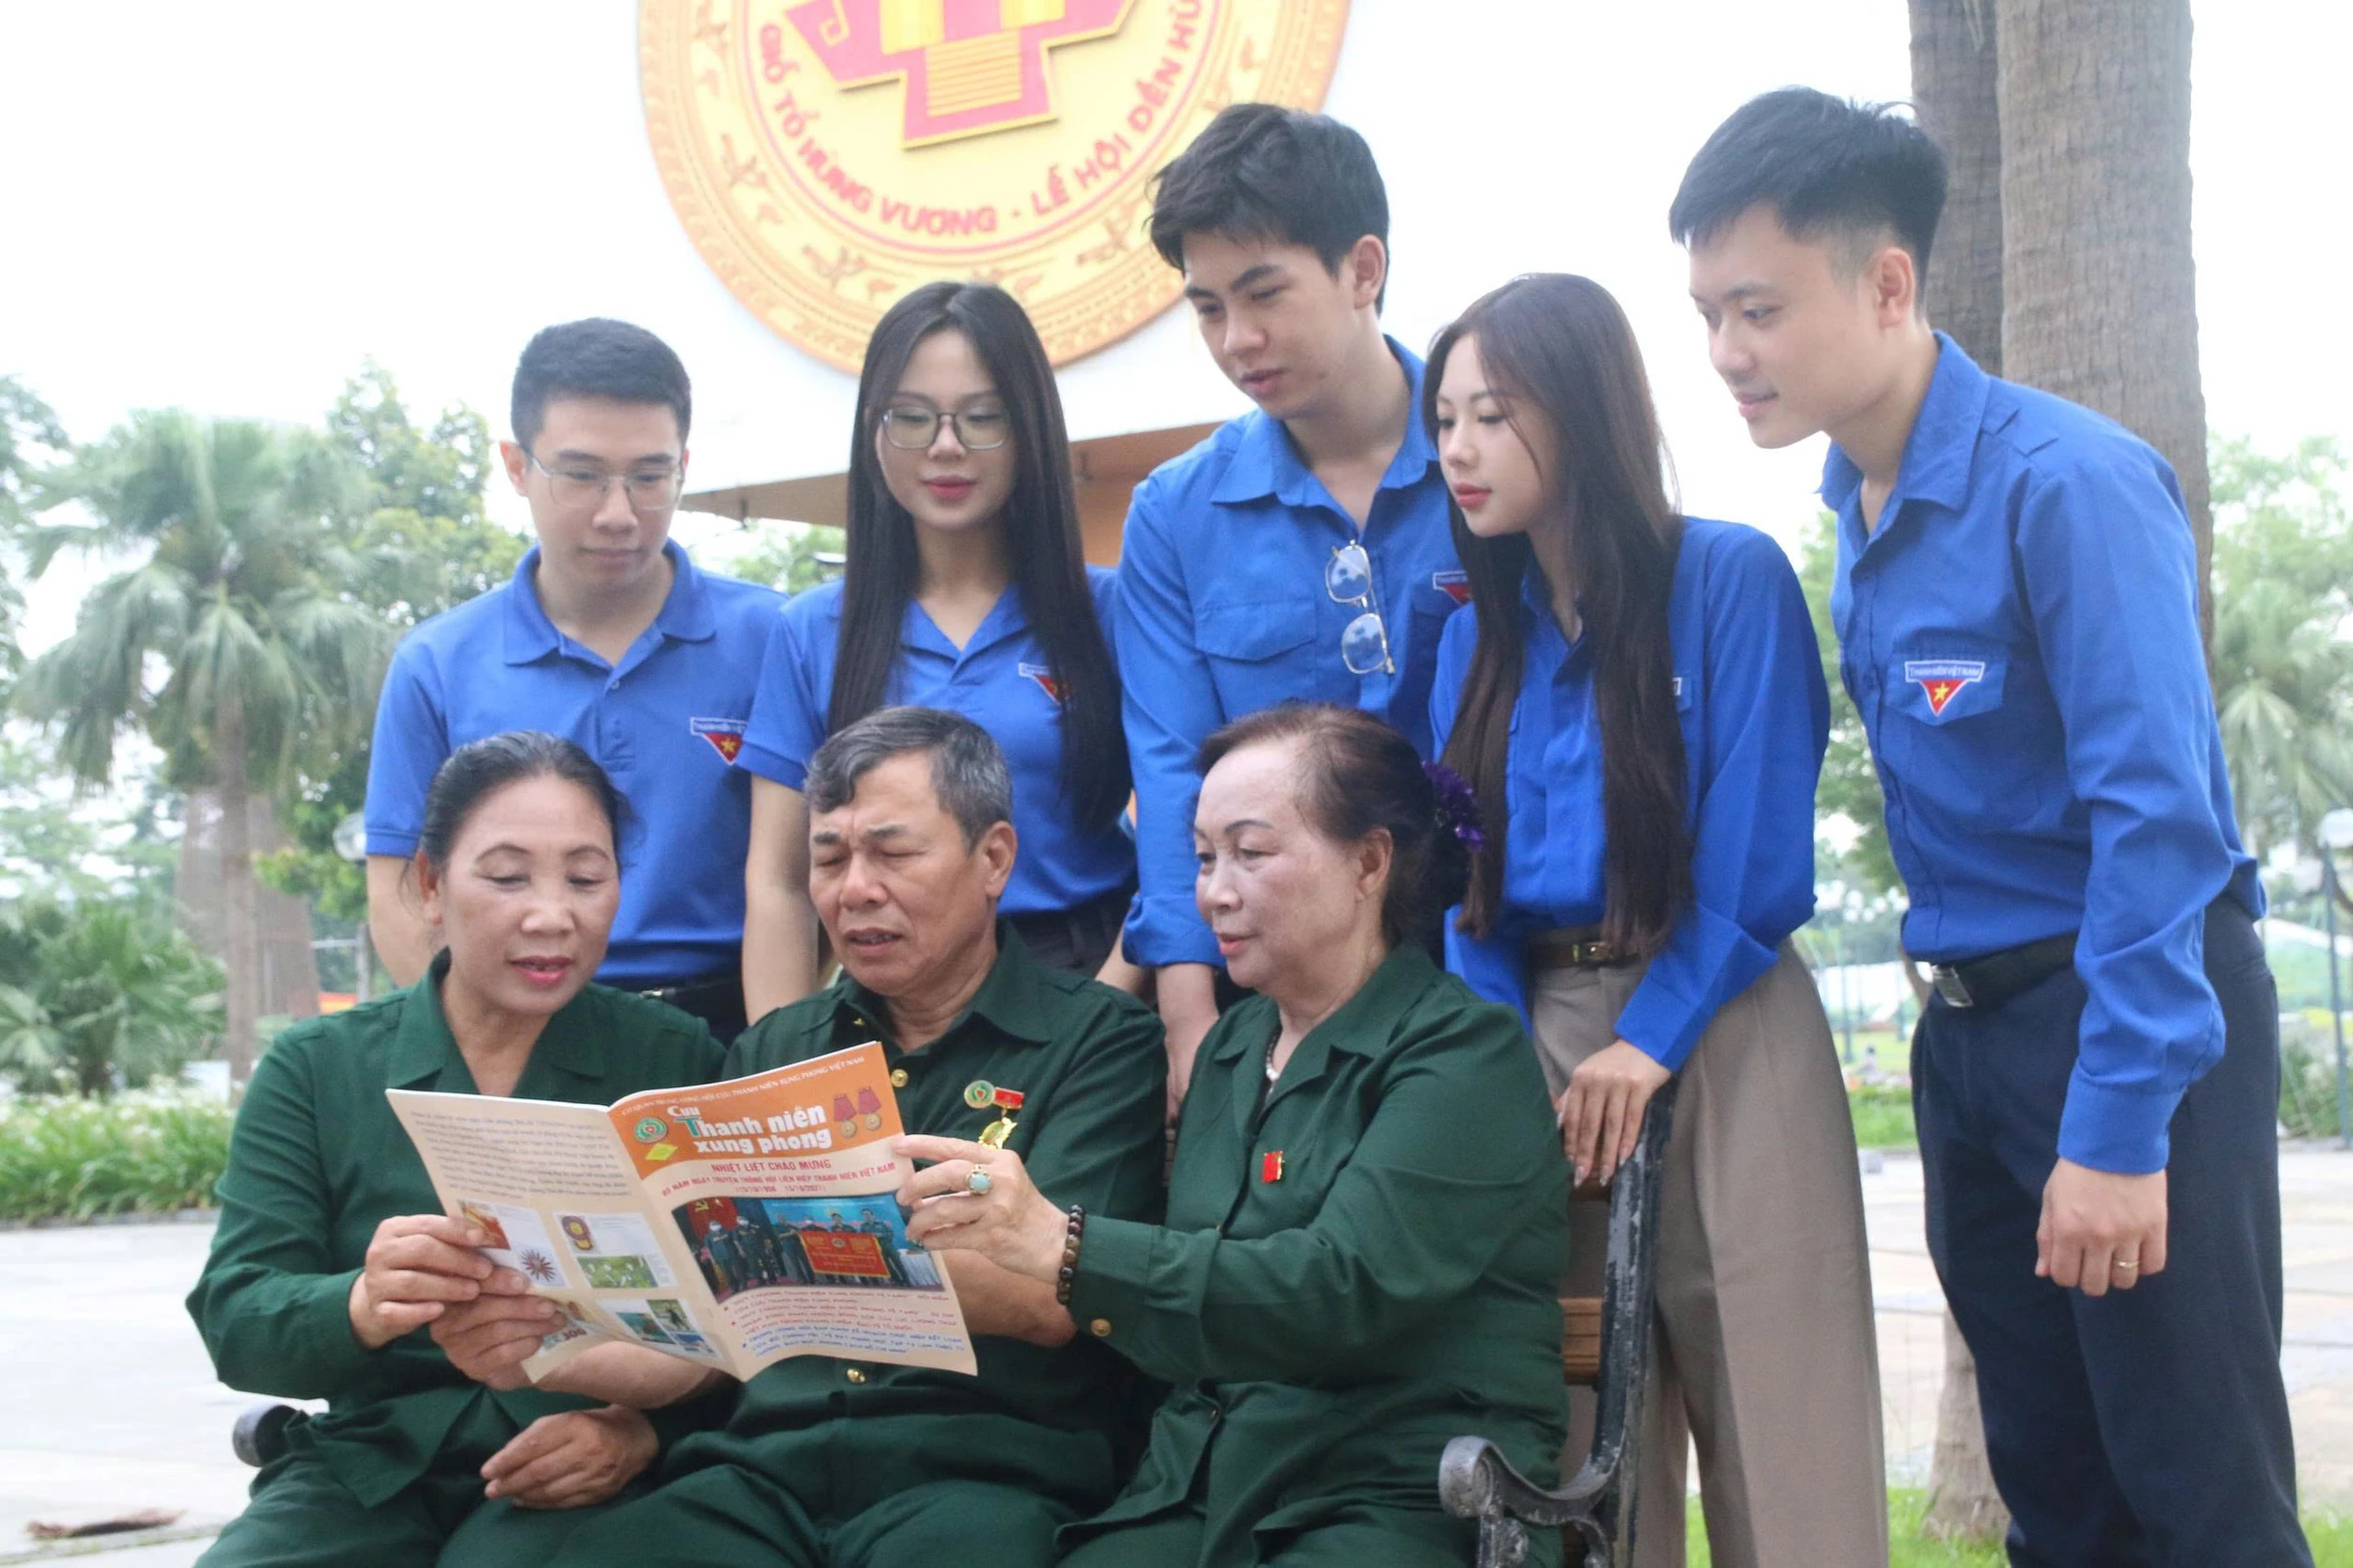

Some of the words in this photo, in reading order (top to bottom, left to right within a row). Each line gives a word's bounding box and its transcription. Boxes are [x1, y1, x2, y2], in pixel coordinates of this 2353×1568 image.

[881, 195, 998, 235] VƯƠNG
[1073, 131, 1132, 191] HỘI
[845, 1056, 865, 1066] NAM
[675, 1116, 763, 1137] Thanh
[767, 1105, 827, 1132] niên
[694, 1138, 755, 1154] xung
[757, 1128, 833, 1154] phong
[877, 1161, 896, 1174] NAM
